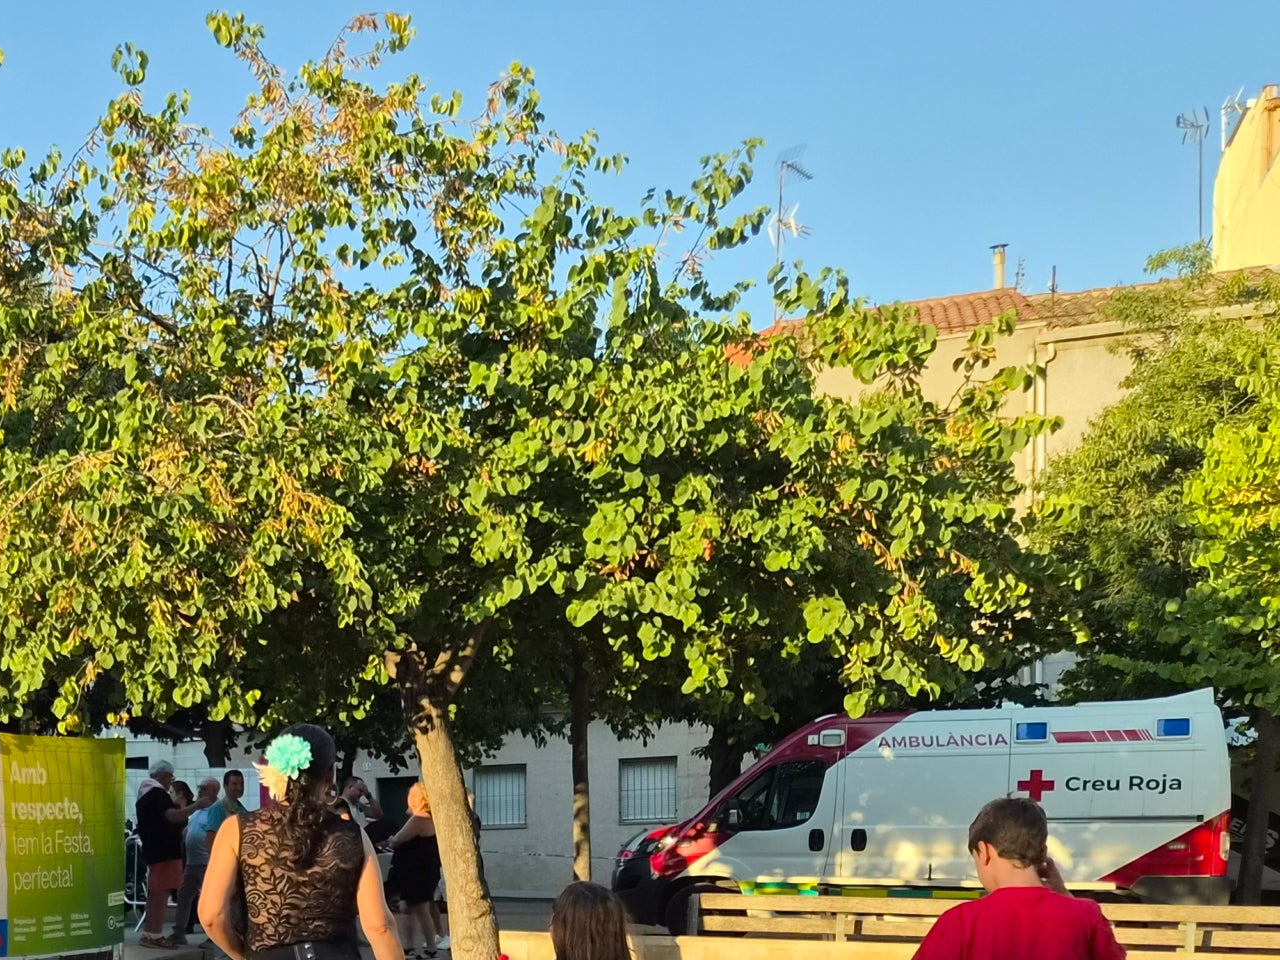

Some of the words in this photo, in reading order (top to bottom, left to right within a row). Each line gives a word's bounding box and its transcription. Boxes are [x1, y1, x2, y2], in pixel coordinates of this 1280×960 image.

[878, 732, 1008, 749] AMBULÀNCIA
[10, 761, 47, 785] Amb
[1065, 776, 1120, 792] Creu
[1129, 774, 1182, 795] Roja
[12, 797, 83, 825] respecte,
[42, 832, 53, 854] la
[55, 830, 94, 856] Festa,
[13, 864, 74, 895] perfecta!
